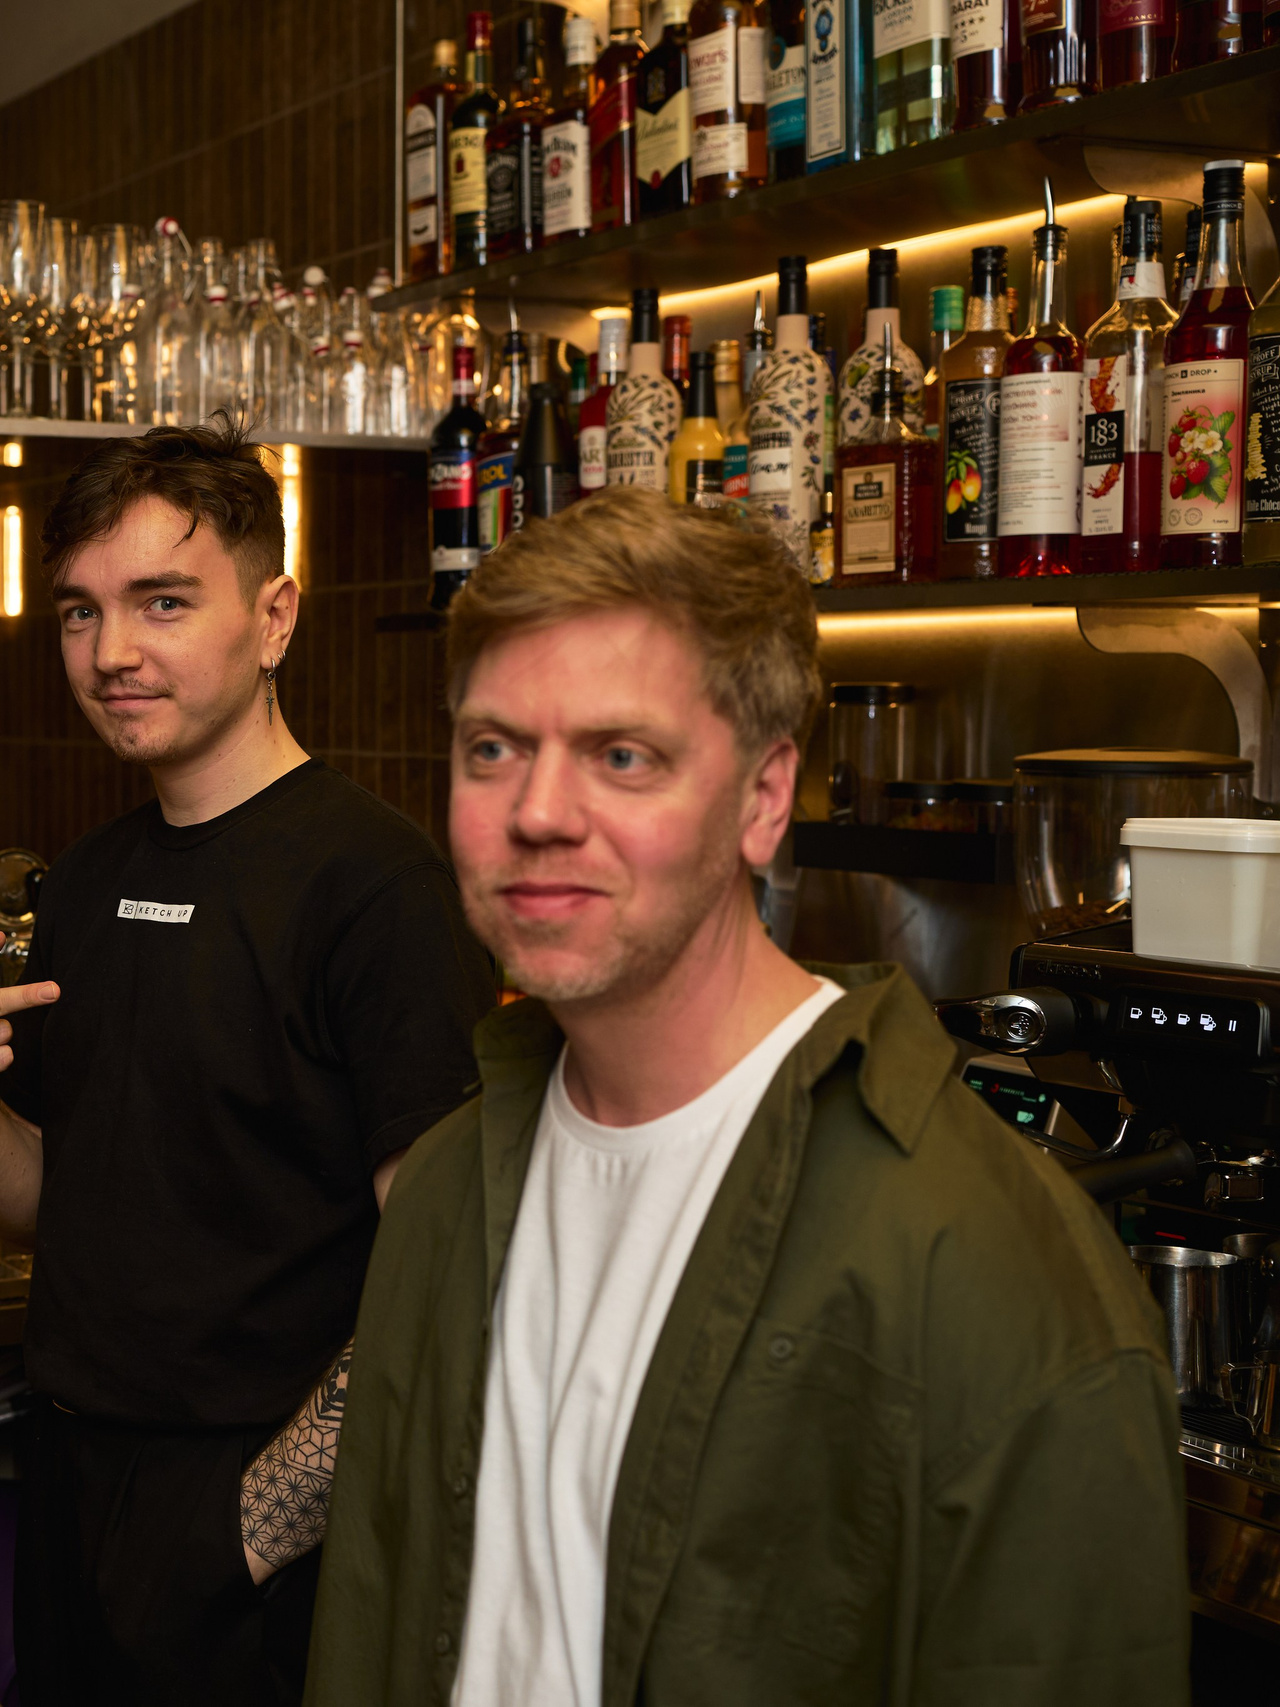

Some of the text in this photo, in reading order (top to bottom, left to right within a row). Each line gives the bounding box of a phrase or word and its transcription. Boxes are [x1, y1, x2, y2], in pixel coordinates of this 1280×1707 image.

[1190, 368, 1212, 377] DROP
[1089, 451, 1117, 461] FRANCE
[138, 906, 189, 918] KETCH UP
